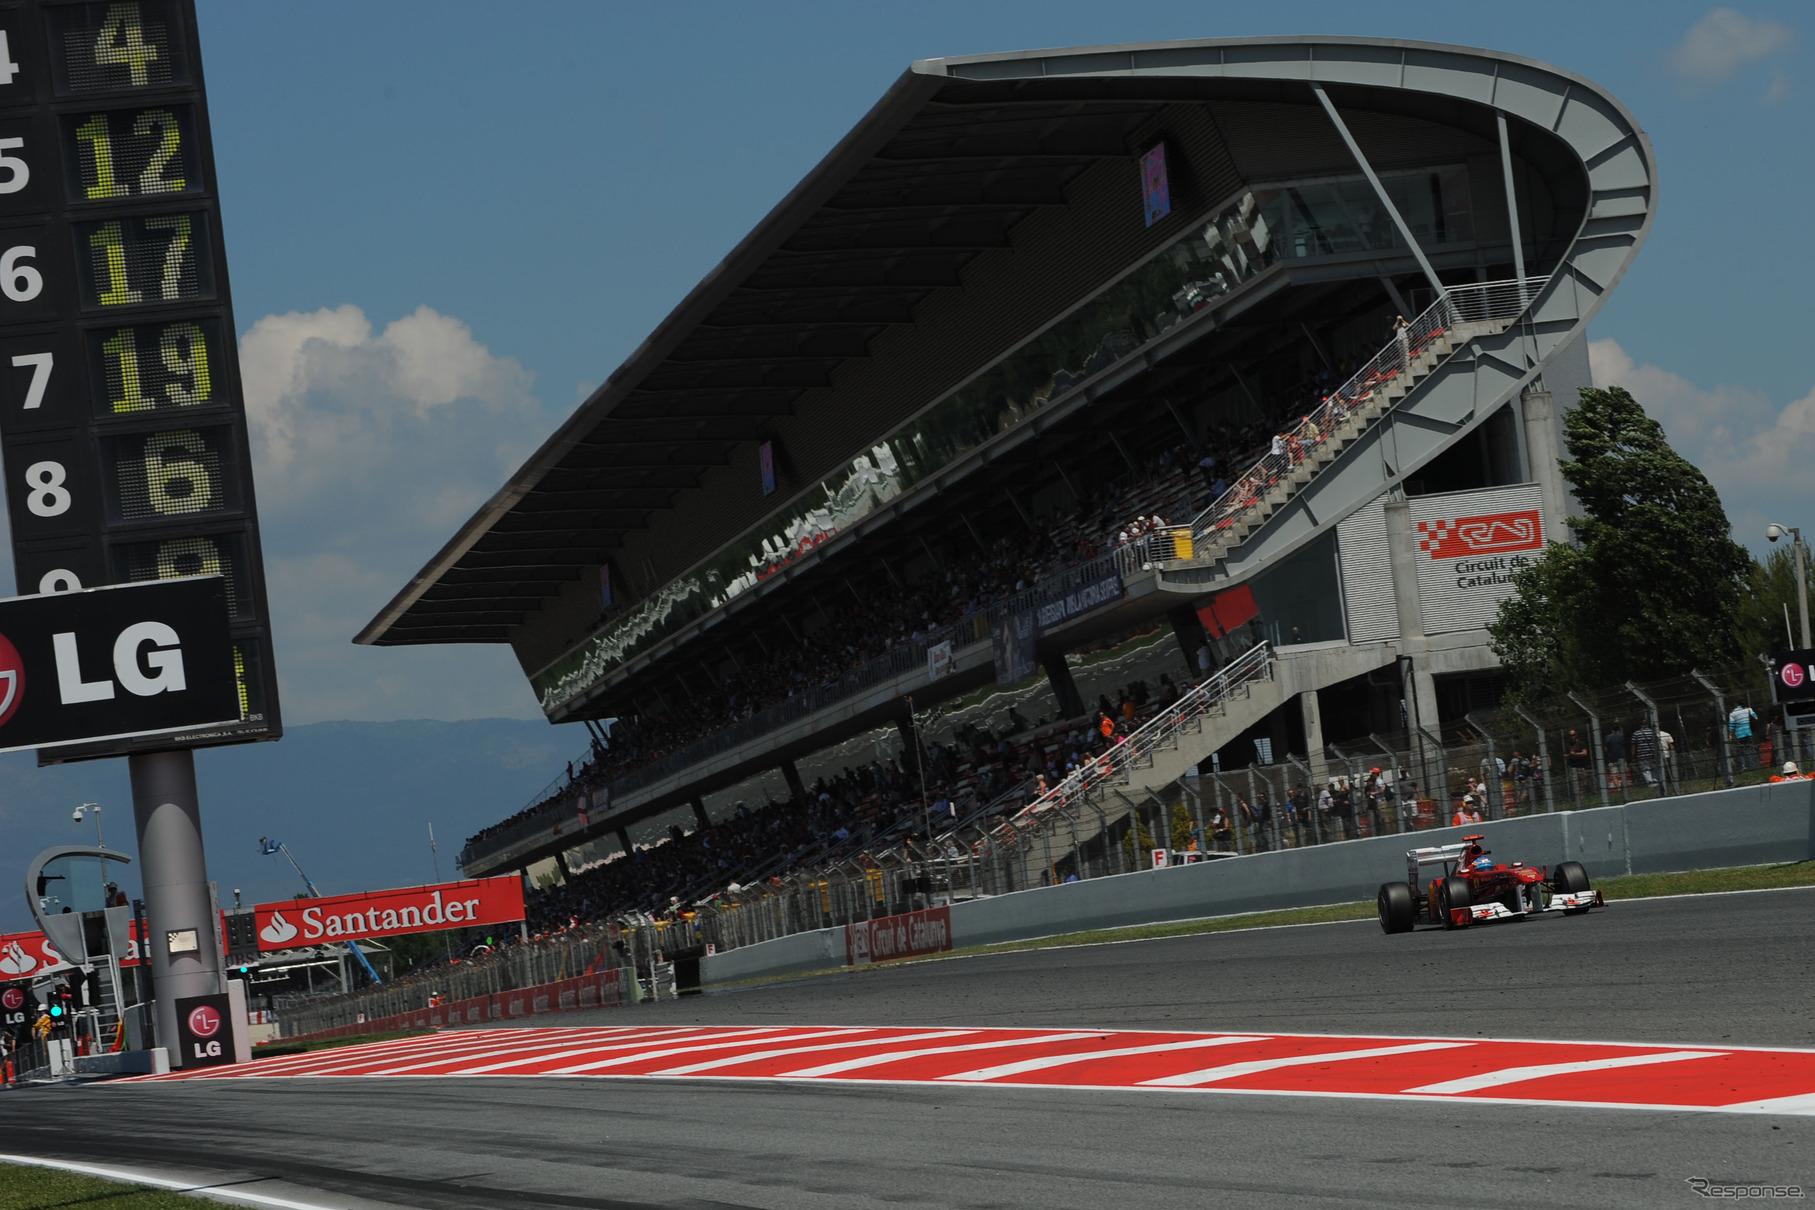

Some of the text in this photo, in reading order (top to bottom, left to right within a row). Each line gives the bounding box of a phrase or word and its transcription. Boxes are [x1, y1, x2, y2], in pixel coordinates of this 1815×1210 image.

[94, 3, 157, 86] 4
[0, 137, 29, 194] 5
[76, 110, 185, 199] 12
[0, 246, 43, 302] 6
[90, 215, 191, 305] 17
[12, 352, 54, 409] 7
[103, 323, 211, 413] 19
[25, 461, 71, 517] 8
[144, 430, 211, 515] 6
[1455, 555, 1530, 574] Circuit de
[53, 621, 187, 705] LG
[1155, 851, 1164, 866] F
[302, 891, 480, 939] Santander
[5, 1012, 26, 1024] LG
[194, 1041, 221, 1058] LG
